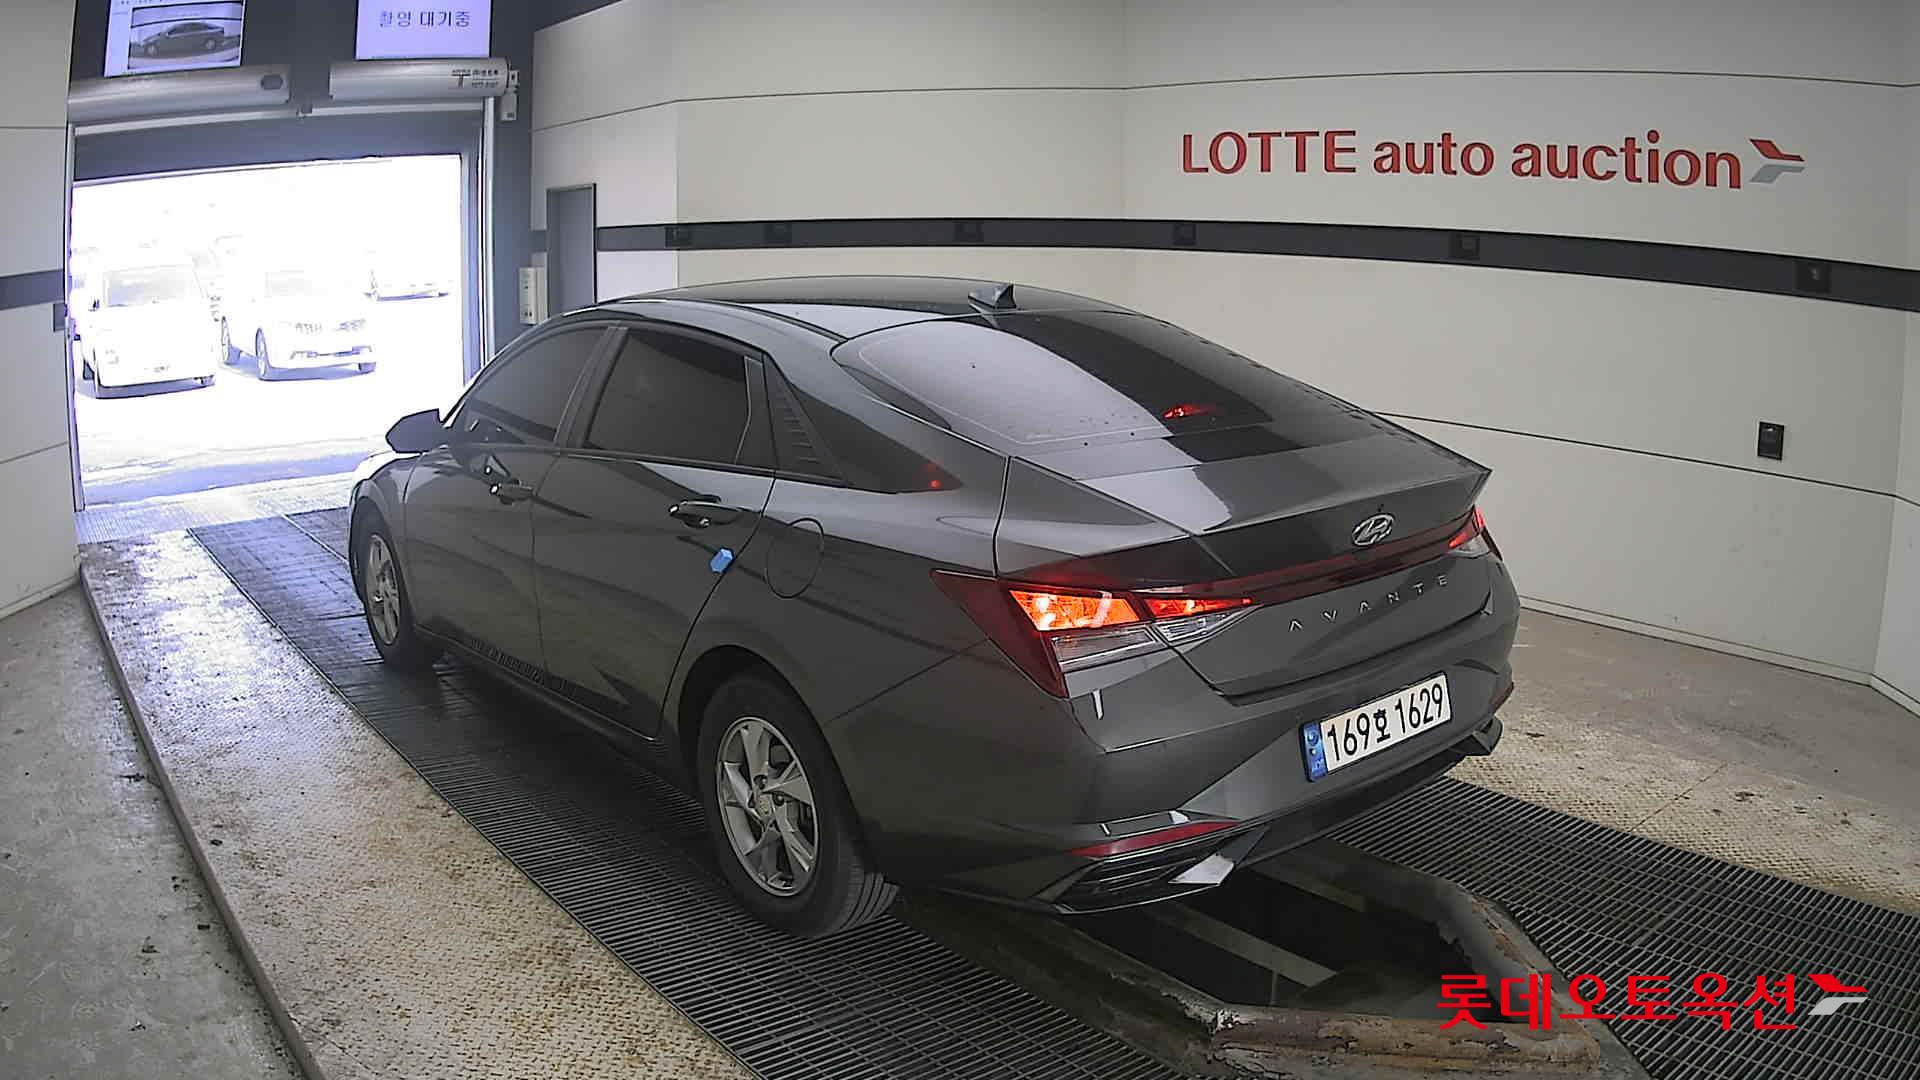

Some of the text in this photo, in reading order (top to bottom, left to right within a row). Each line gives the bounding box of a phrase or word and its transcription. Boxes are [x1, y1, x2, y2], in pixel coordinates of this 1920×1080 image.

[417, 10, 470, 28] 대기중
[1182, 129, 1742, 189] LOTTE auto auction
[1288, 575, 1449, 633] AVANTE
[1327, 683, 1443, 762] 169호 1629
